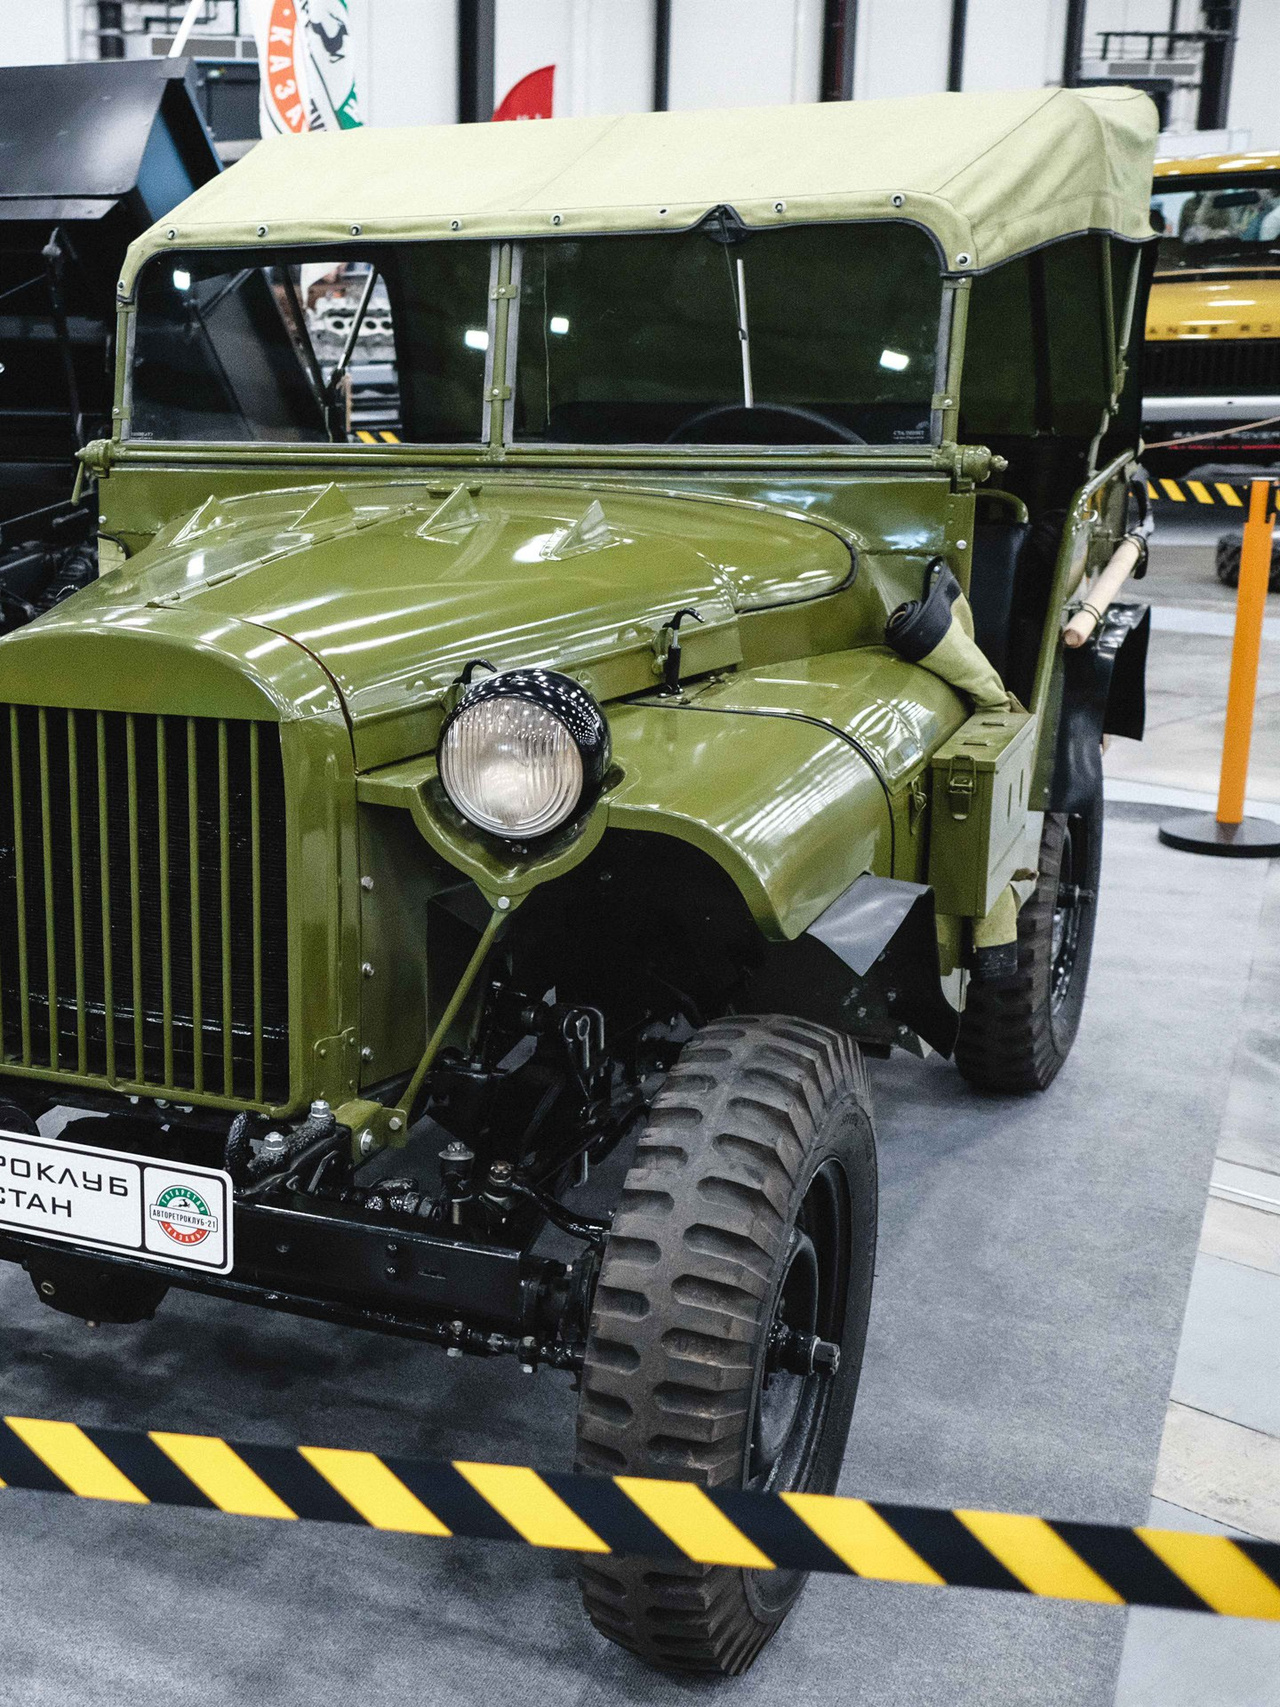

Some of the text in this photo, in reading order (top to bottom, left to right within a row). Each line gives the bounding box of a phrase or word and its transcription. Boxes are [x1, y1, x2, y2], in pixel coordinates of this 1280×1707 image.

[269, 26, 303, 126] КАЗА
[1148, 322, 1280, 334] ANGE RO
[161, 1189, 206, 1212] ТАТАРСТАН
[152, 1209, 216, 1228] АВТОРЕТРОКЛУБ-21
[166, 1226, 201, 1242] КАЗАНЬ
